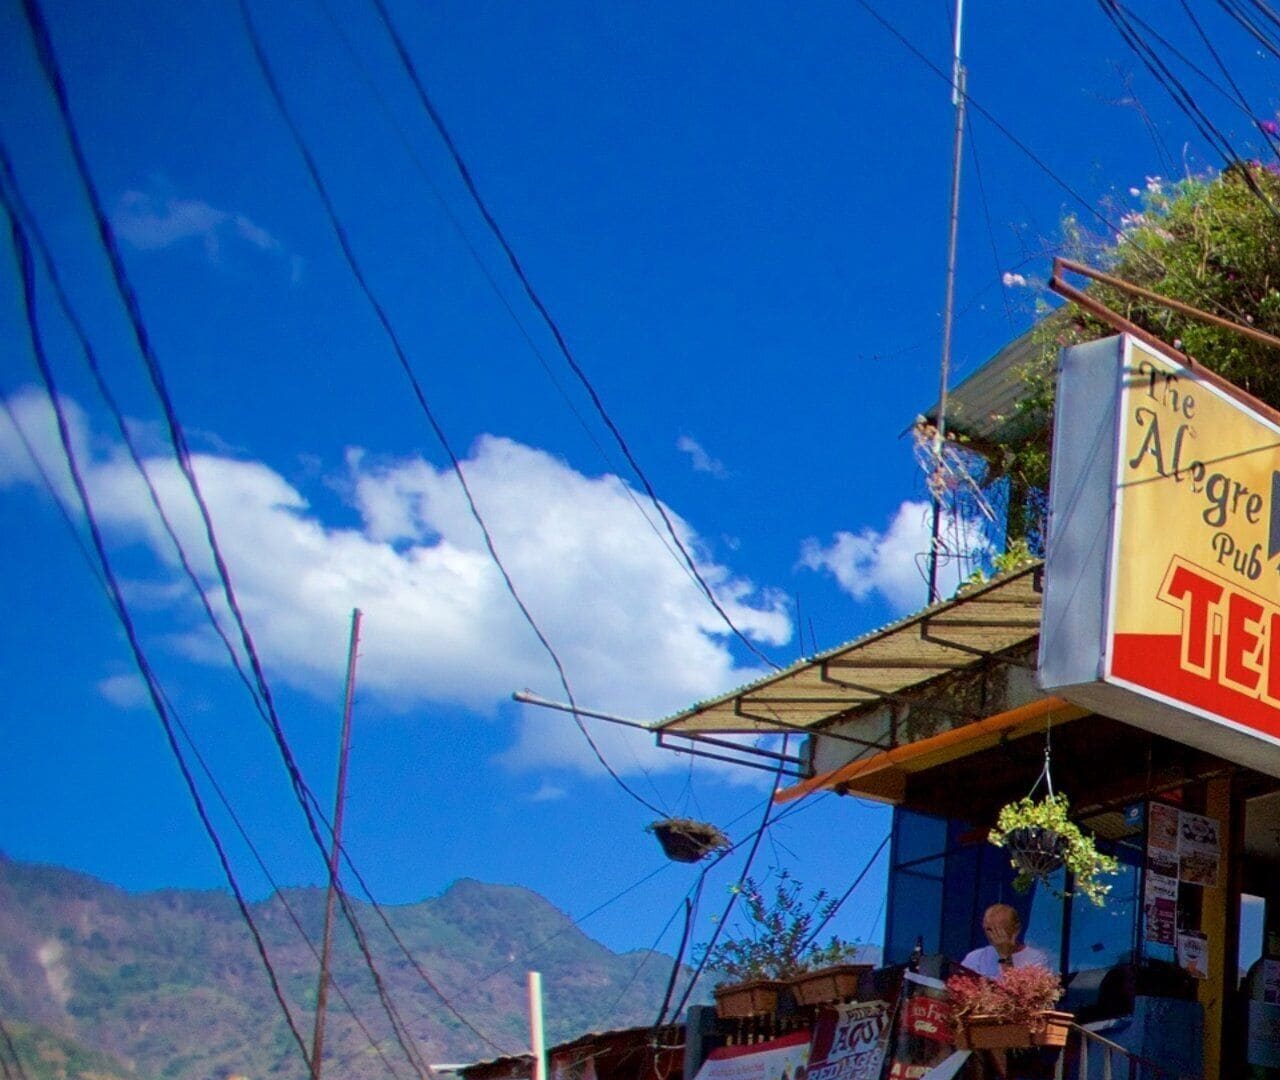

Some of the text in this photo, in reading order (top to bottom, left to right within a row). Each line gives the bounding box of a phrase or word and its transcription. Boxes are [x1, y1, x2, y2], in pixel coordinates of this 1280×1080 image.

[1138, 360, 1196, 420] The
[1128, 406, 1264, 528] Alegre
[1212, 532, 1263, 580] Pub
